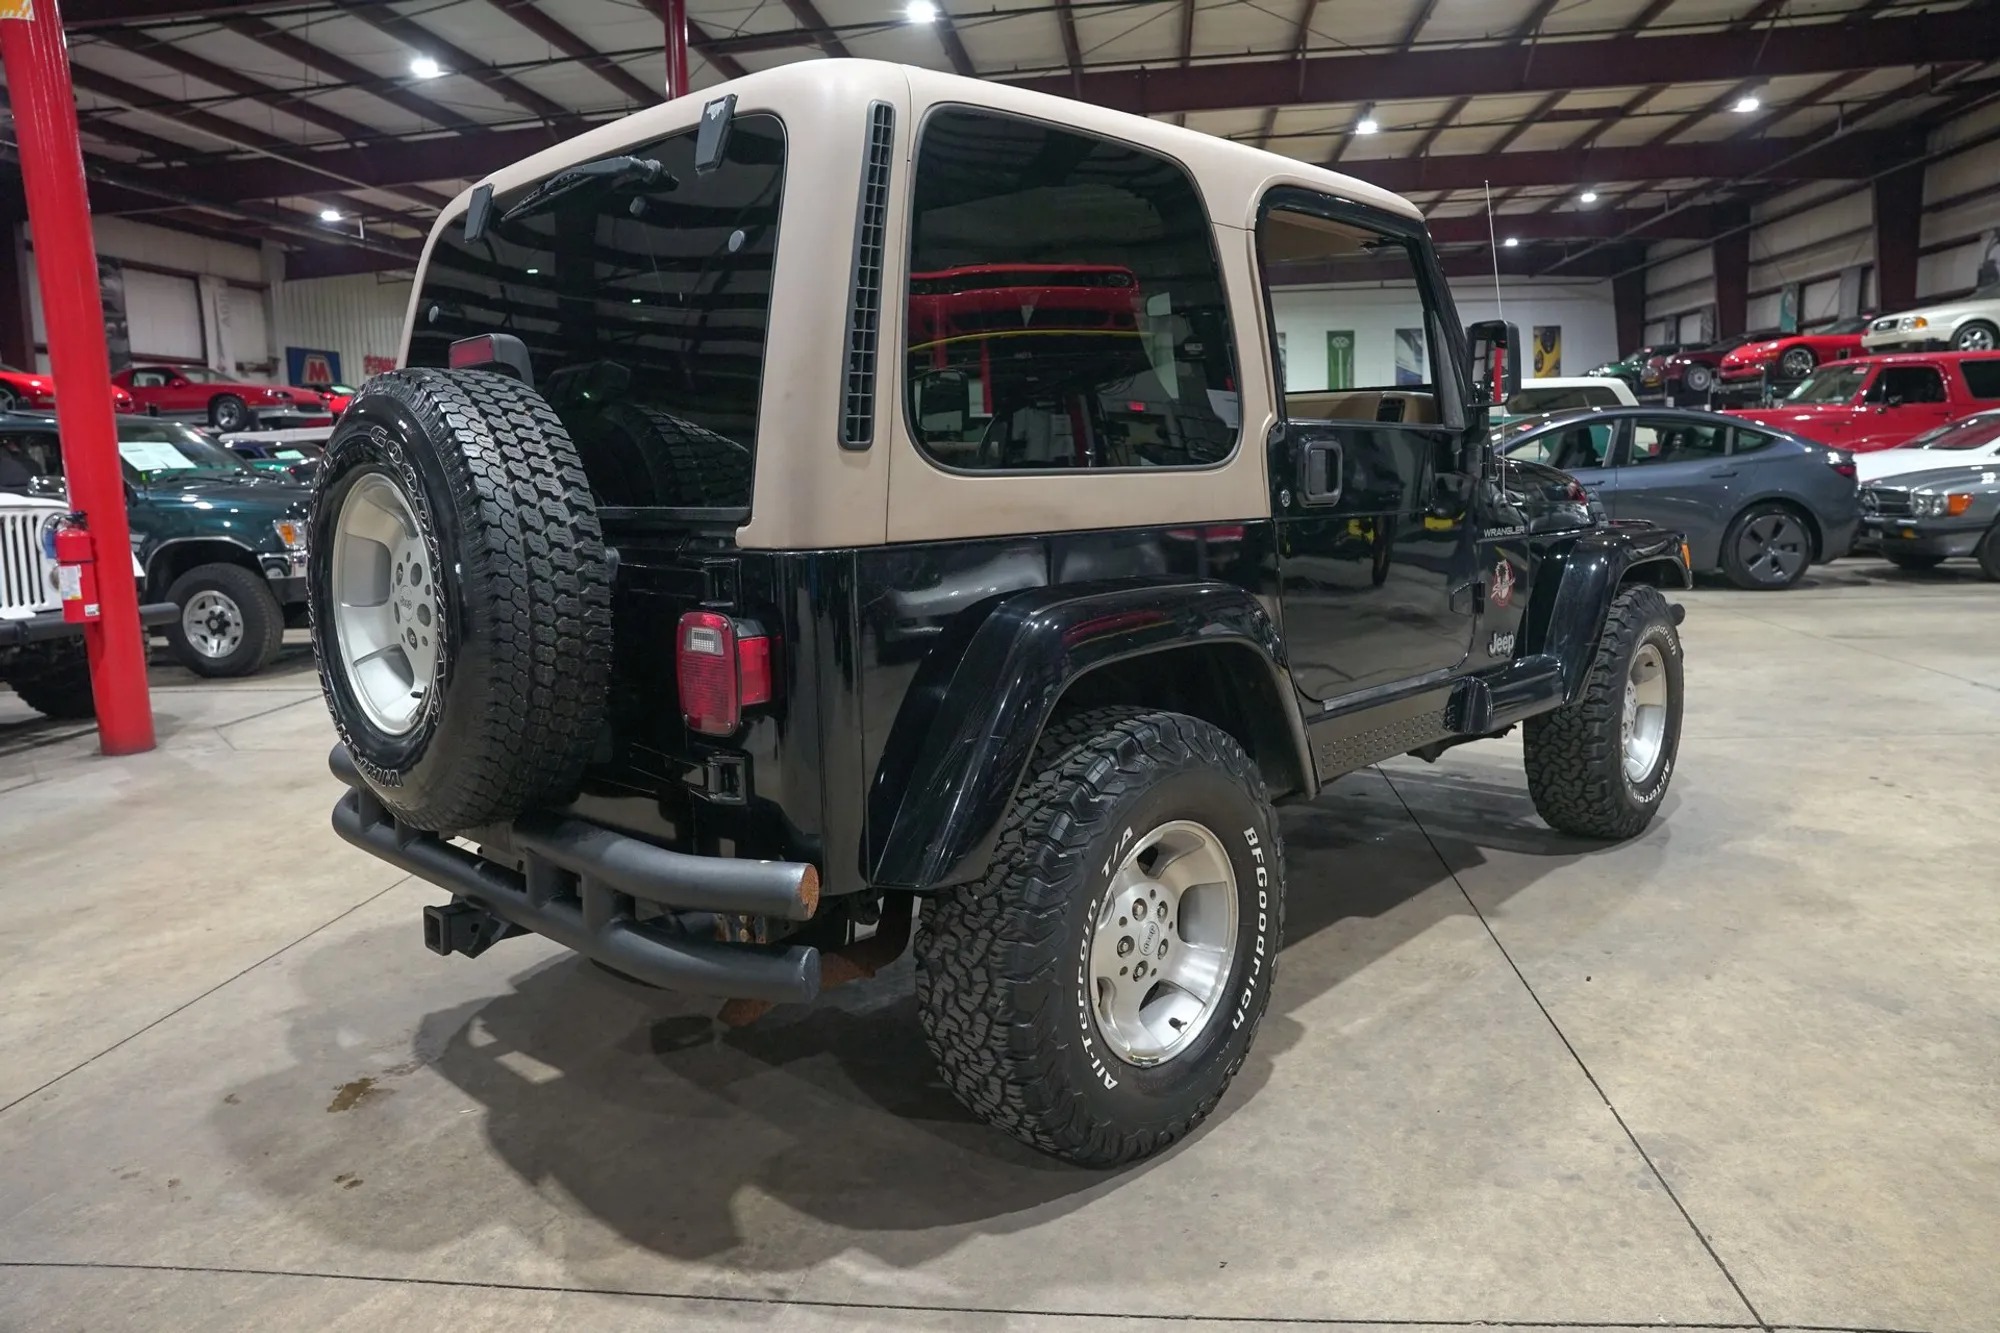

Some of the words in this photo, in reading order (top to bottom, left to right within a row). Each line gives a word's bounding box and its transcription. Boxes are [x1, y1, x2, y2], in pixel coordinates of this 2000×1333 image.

[308, 361, 330, 383] M
[1483, 525, 1525, 538] WRANGLER
[1489, 631, 1514, 655] Jeep
[1232, 826, 1268, 1030] BFGoodrich
[1077, 898, 1118, 1091] All-Terrain
[1101, 826, 1133, 878] T/A
